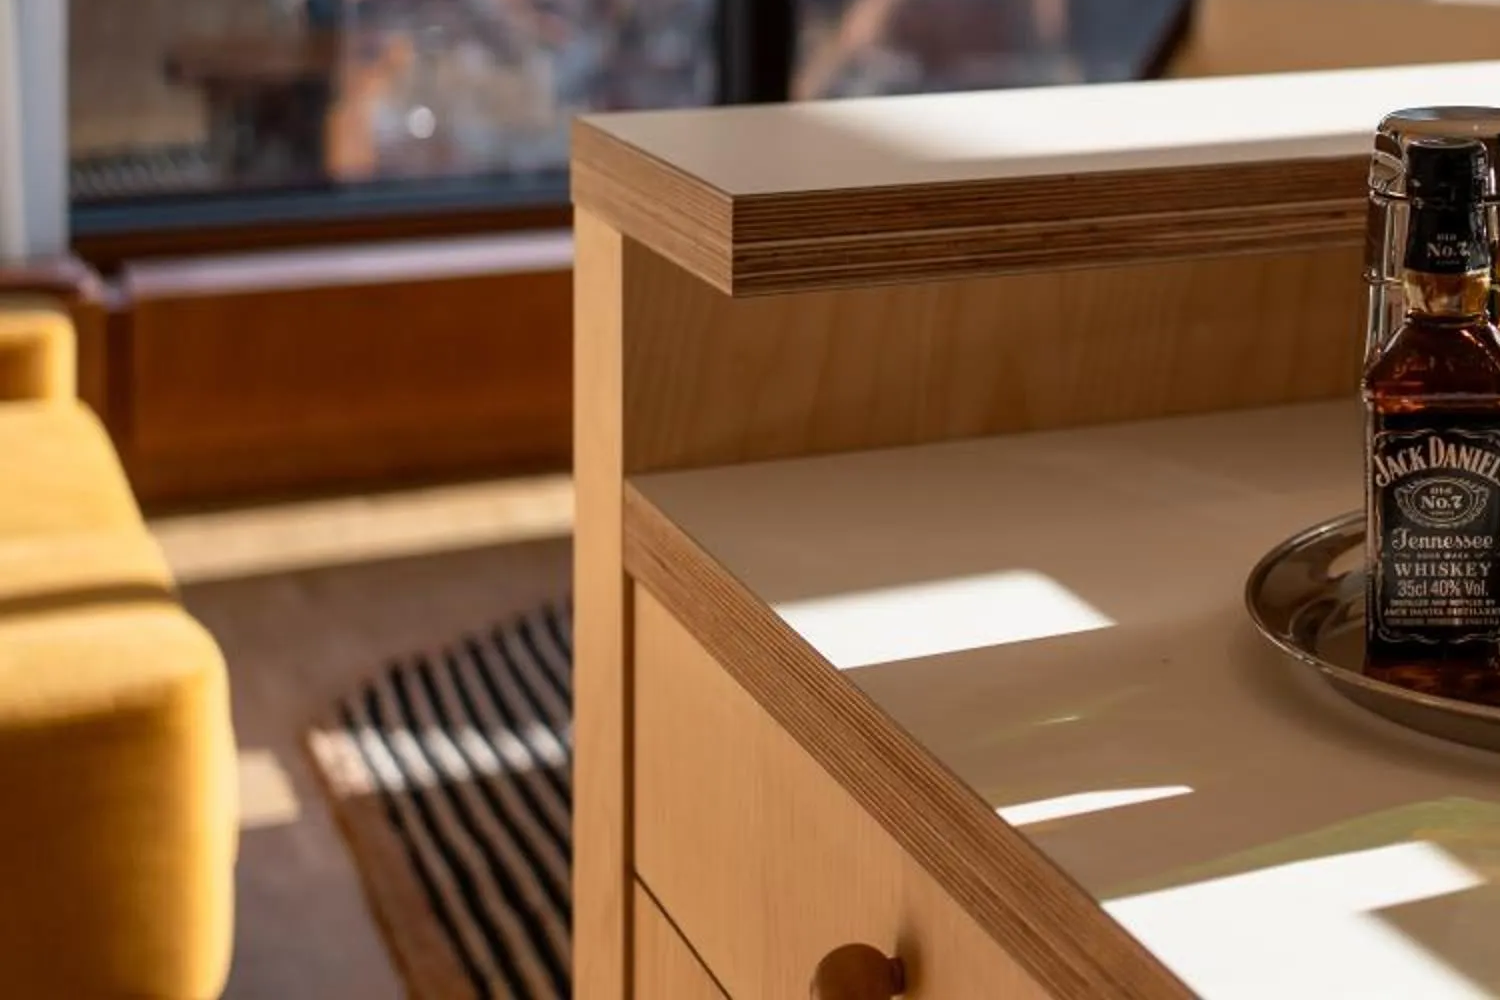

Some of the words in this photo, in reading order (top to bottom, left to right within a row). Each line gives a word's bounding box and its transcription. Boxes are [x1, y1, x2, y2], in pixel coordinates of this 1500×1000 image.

[1373, 444, 1427, 487] JACK
[1420, 495, 1464, 509] No.7
[1391, 527, 1494, 550] Tennessee
[1394, 562, 1492, 577] WHISKEY
[1397, 579, 1428, 598] 35cl
[1430, 579, 1462, 598] 40%
[1463, 579, 1489, 597] Vol.
